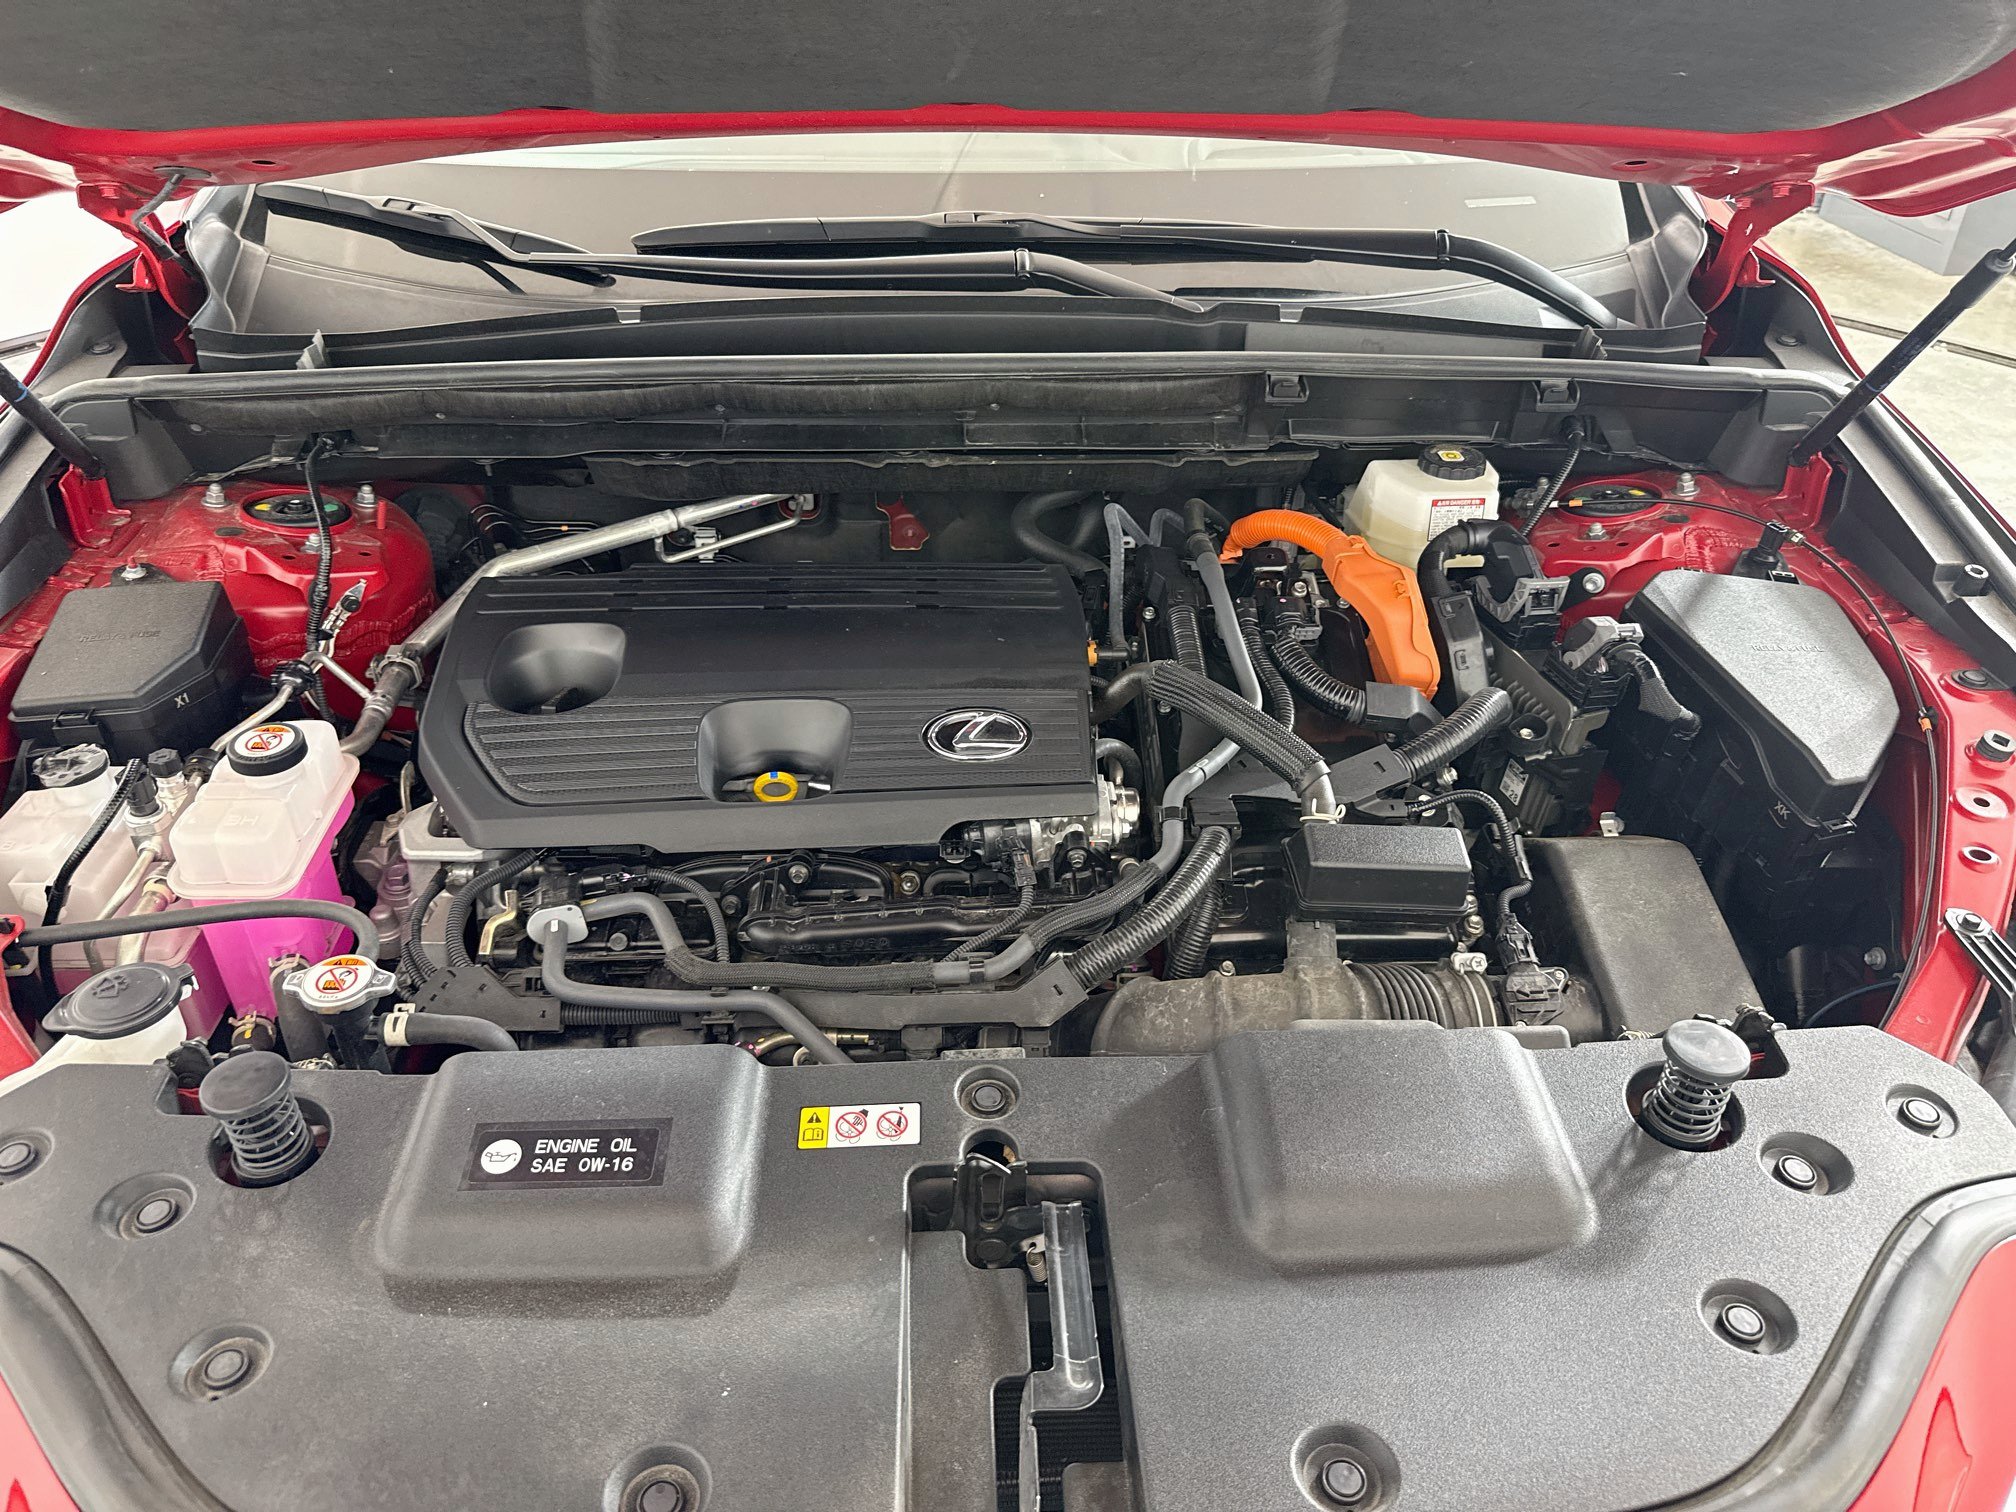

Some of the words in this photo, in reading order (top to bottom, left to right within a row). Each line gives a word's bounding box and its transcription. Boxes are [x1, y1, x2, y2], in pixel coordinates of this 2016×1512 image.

[174, 692, 190, 709] X1
[1773, 800, 1791, 820] XK
[534, 1138, 600, 1154] ENGINE
[610, 1137, 638, 1152] OIL
[530, 1157, 568, 1173] SAE
[578, 1156, 634, 1173] 0W-16
